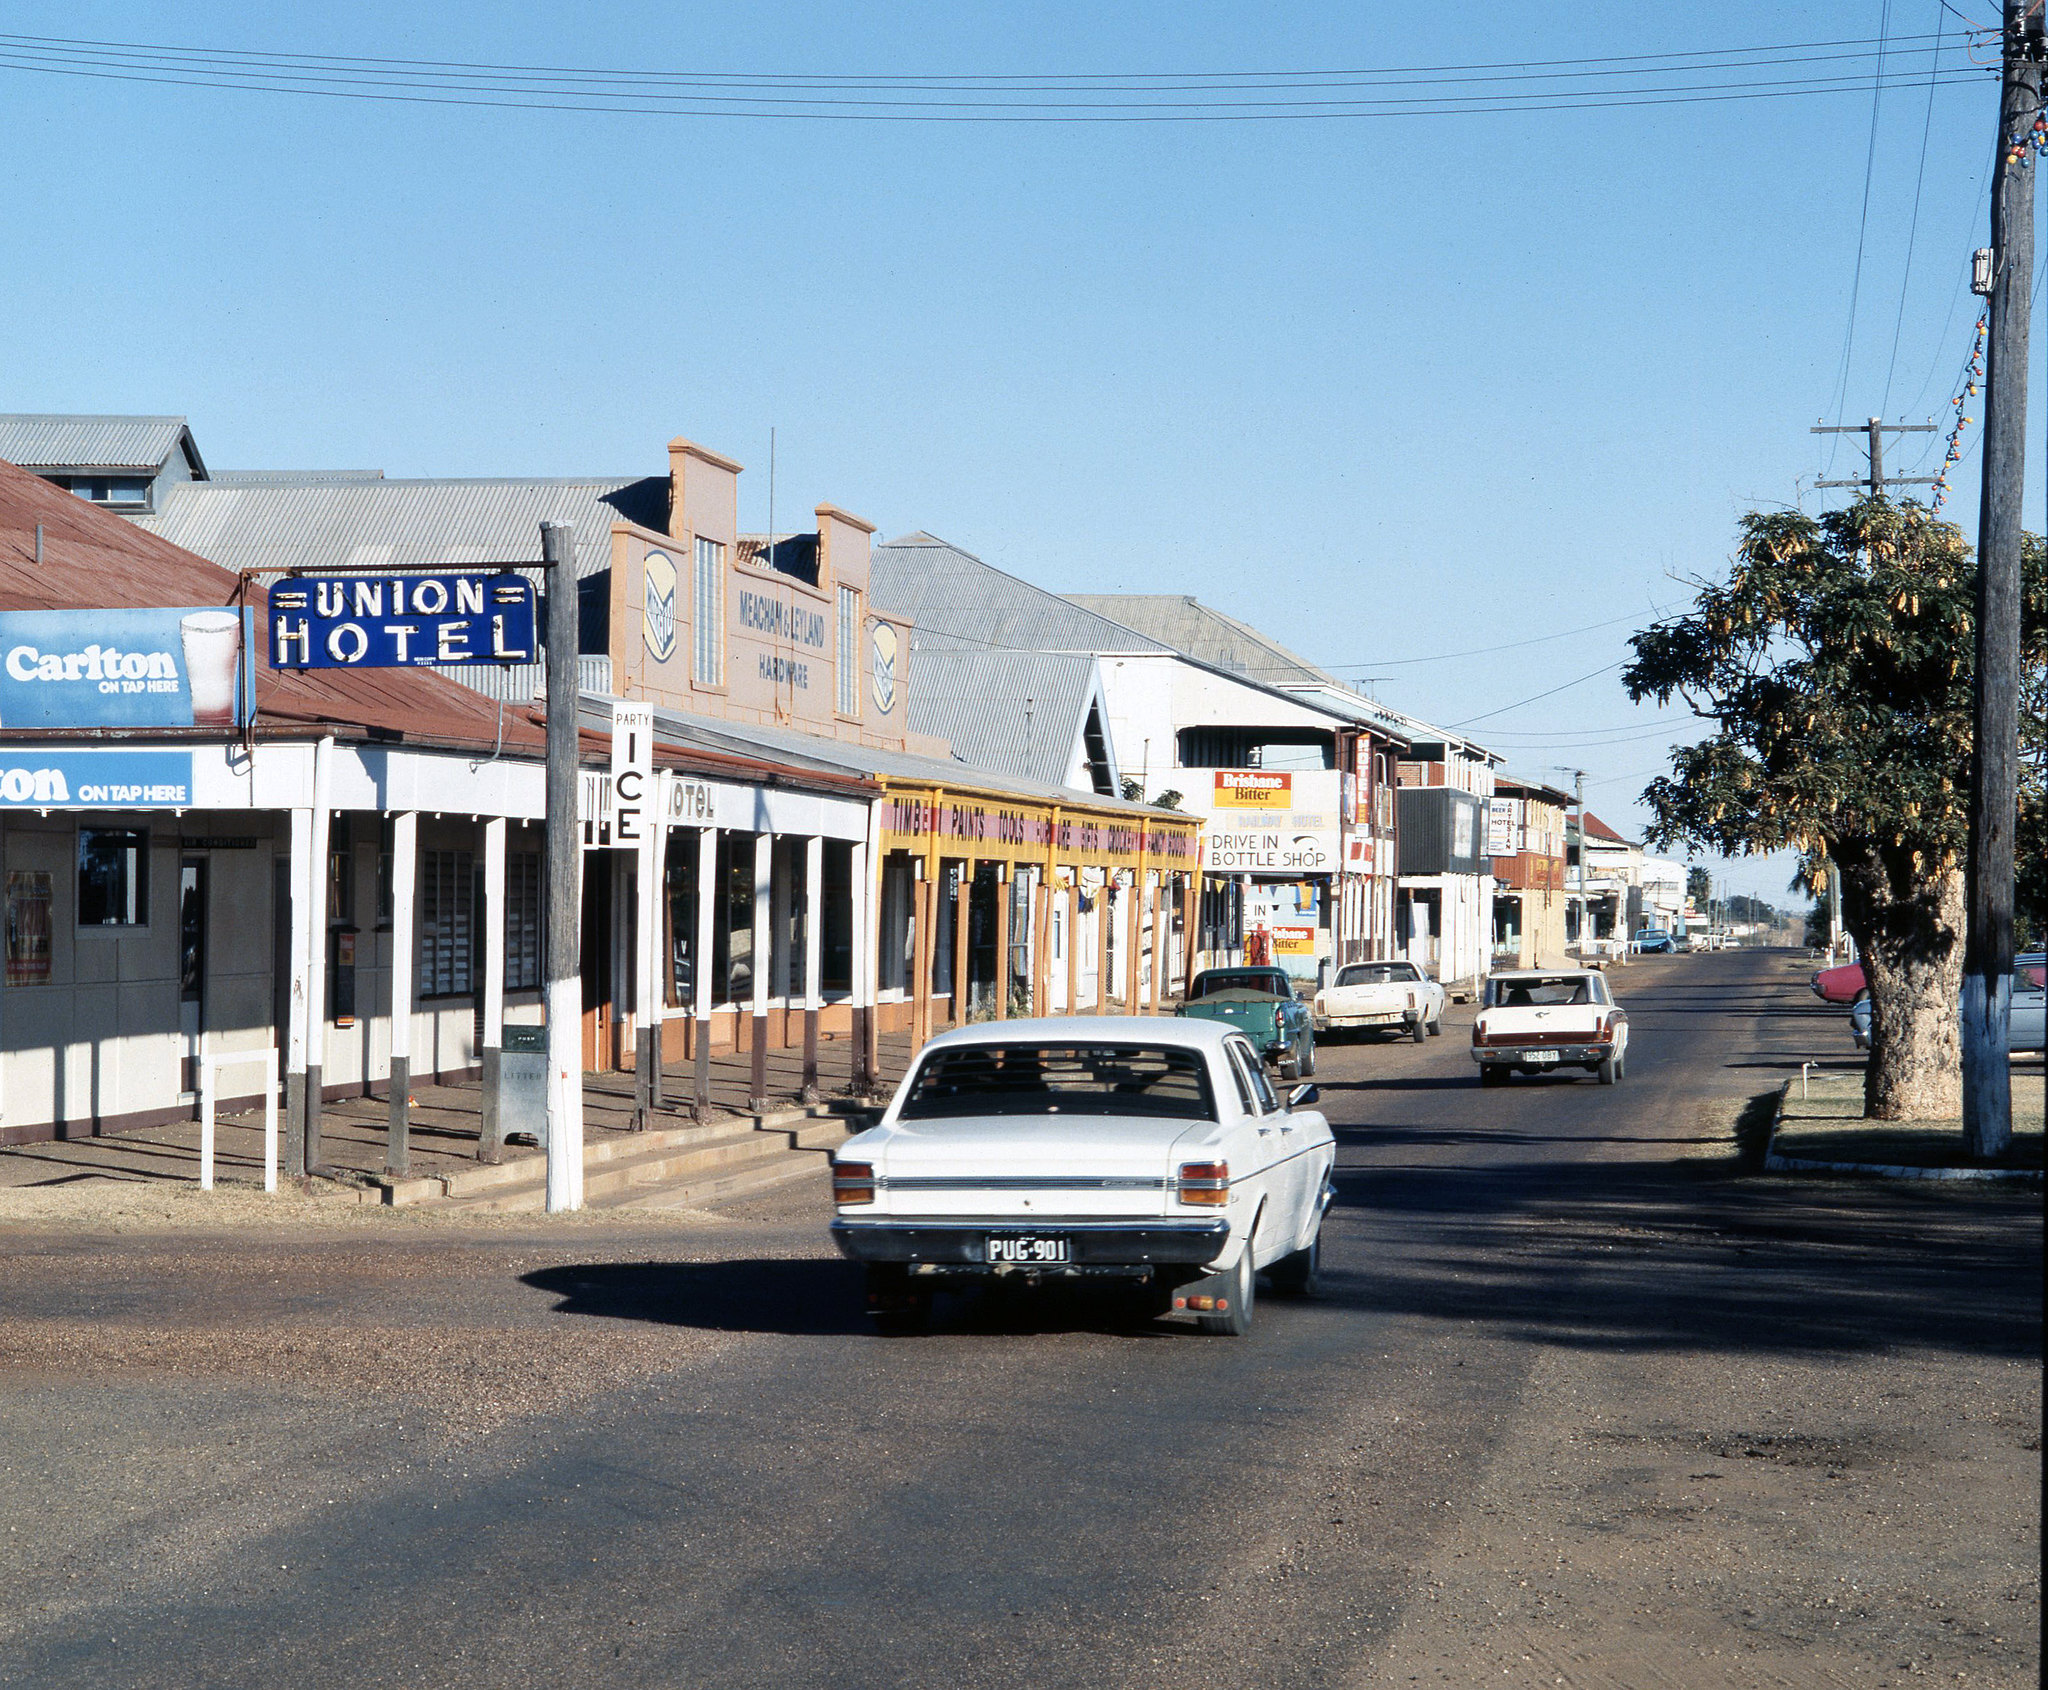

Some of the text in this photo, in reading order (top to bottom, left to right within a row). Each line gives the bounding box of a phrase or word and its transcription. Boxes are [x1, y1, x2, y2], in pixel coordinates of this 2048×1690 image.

[316, 579, 484, 618] UNION
[739, 590, 825, 648] MEACHAM & LEYLAND
[277, 614, 527, 664] HOTEL
[5, 644, 179, 682] Carlton
[758, 653, 808, 689] HARDWARE
[98, 680, 179, 694] ON TAP HERE
[616, 713, 650, 726] PARTY
[0, 768, 70, 802] on
[616, 732, 644, 839] ICE
[1222, 773, 1283, 789] Brisbane
[1357, 738, 1370, 804] HOTEL
[78, 785, 186, 801] ON TAP HERE
[1234, 787, 1271, 800] Bitter
[893, 797, 943, 837] TIMBE
[951, 804, 985, 842] PAINTS
[998, 810, 1025, 846] TOOLS
[1491, 818, 1517, 827] HOTEL
[1212, 834, 1279, 849] DRIVE IN
[1211, 852, 1326, 867] BOTTLE SHOP
